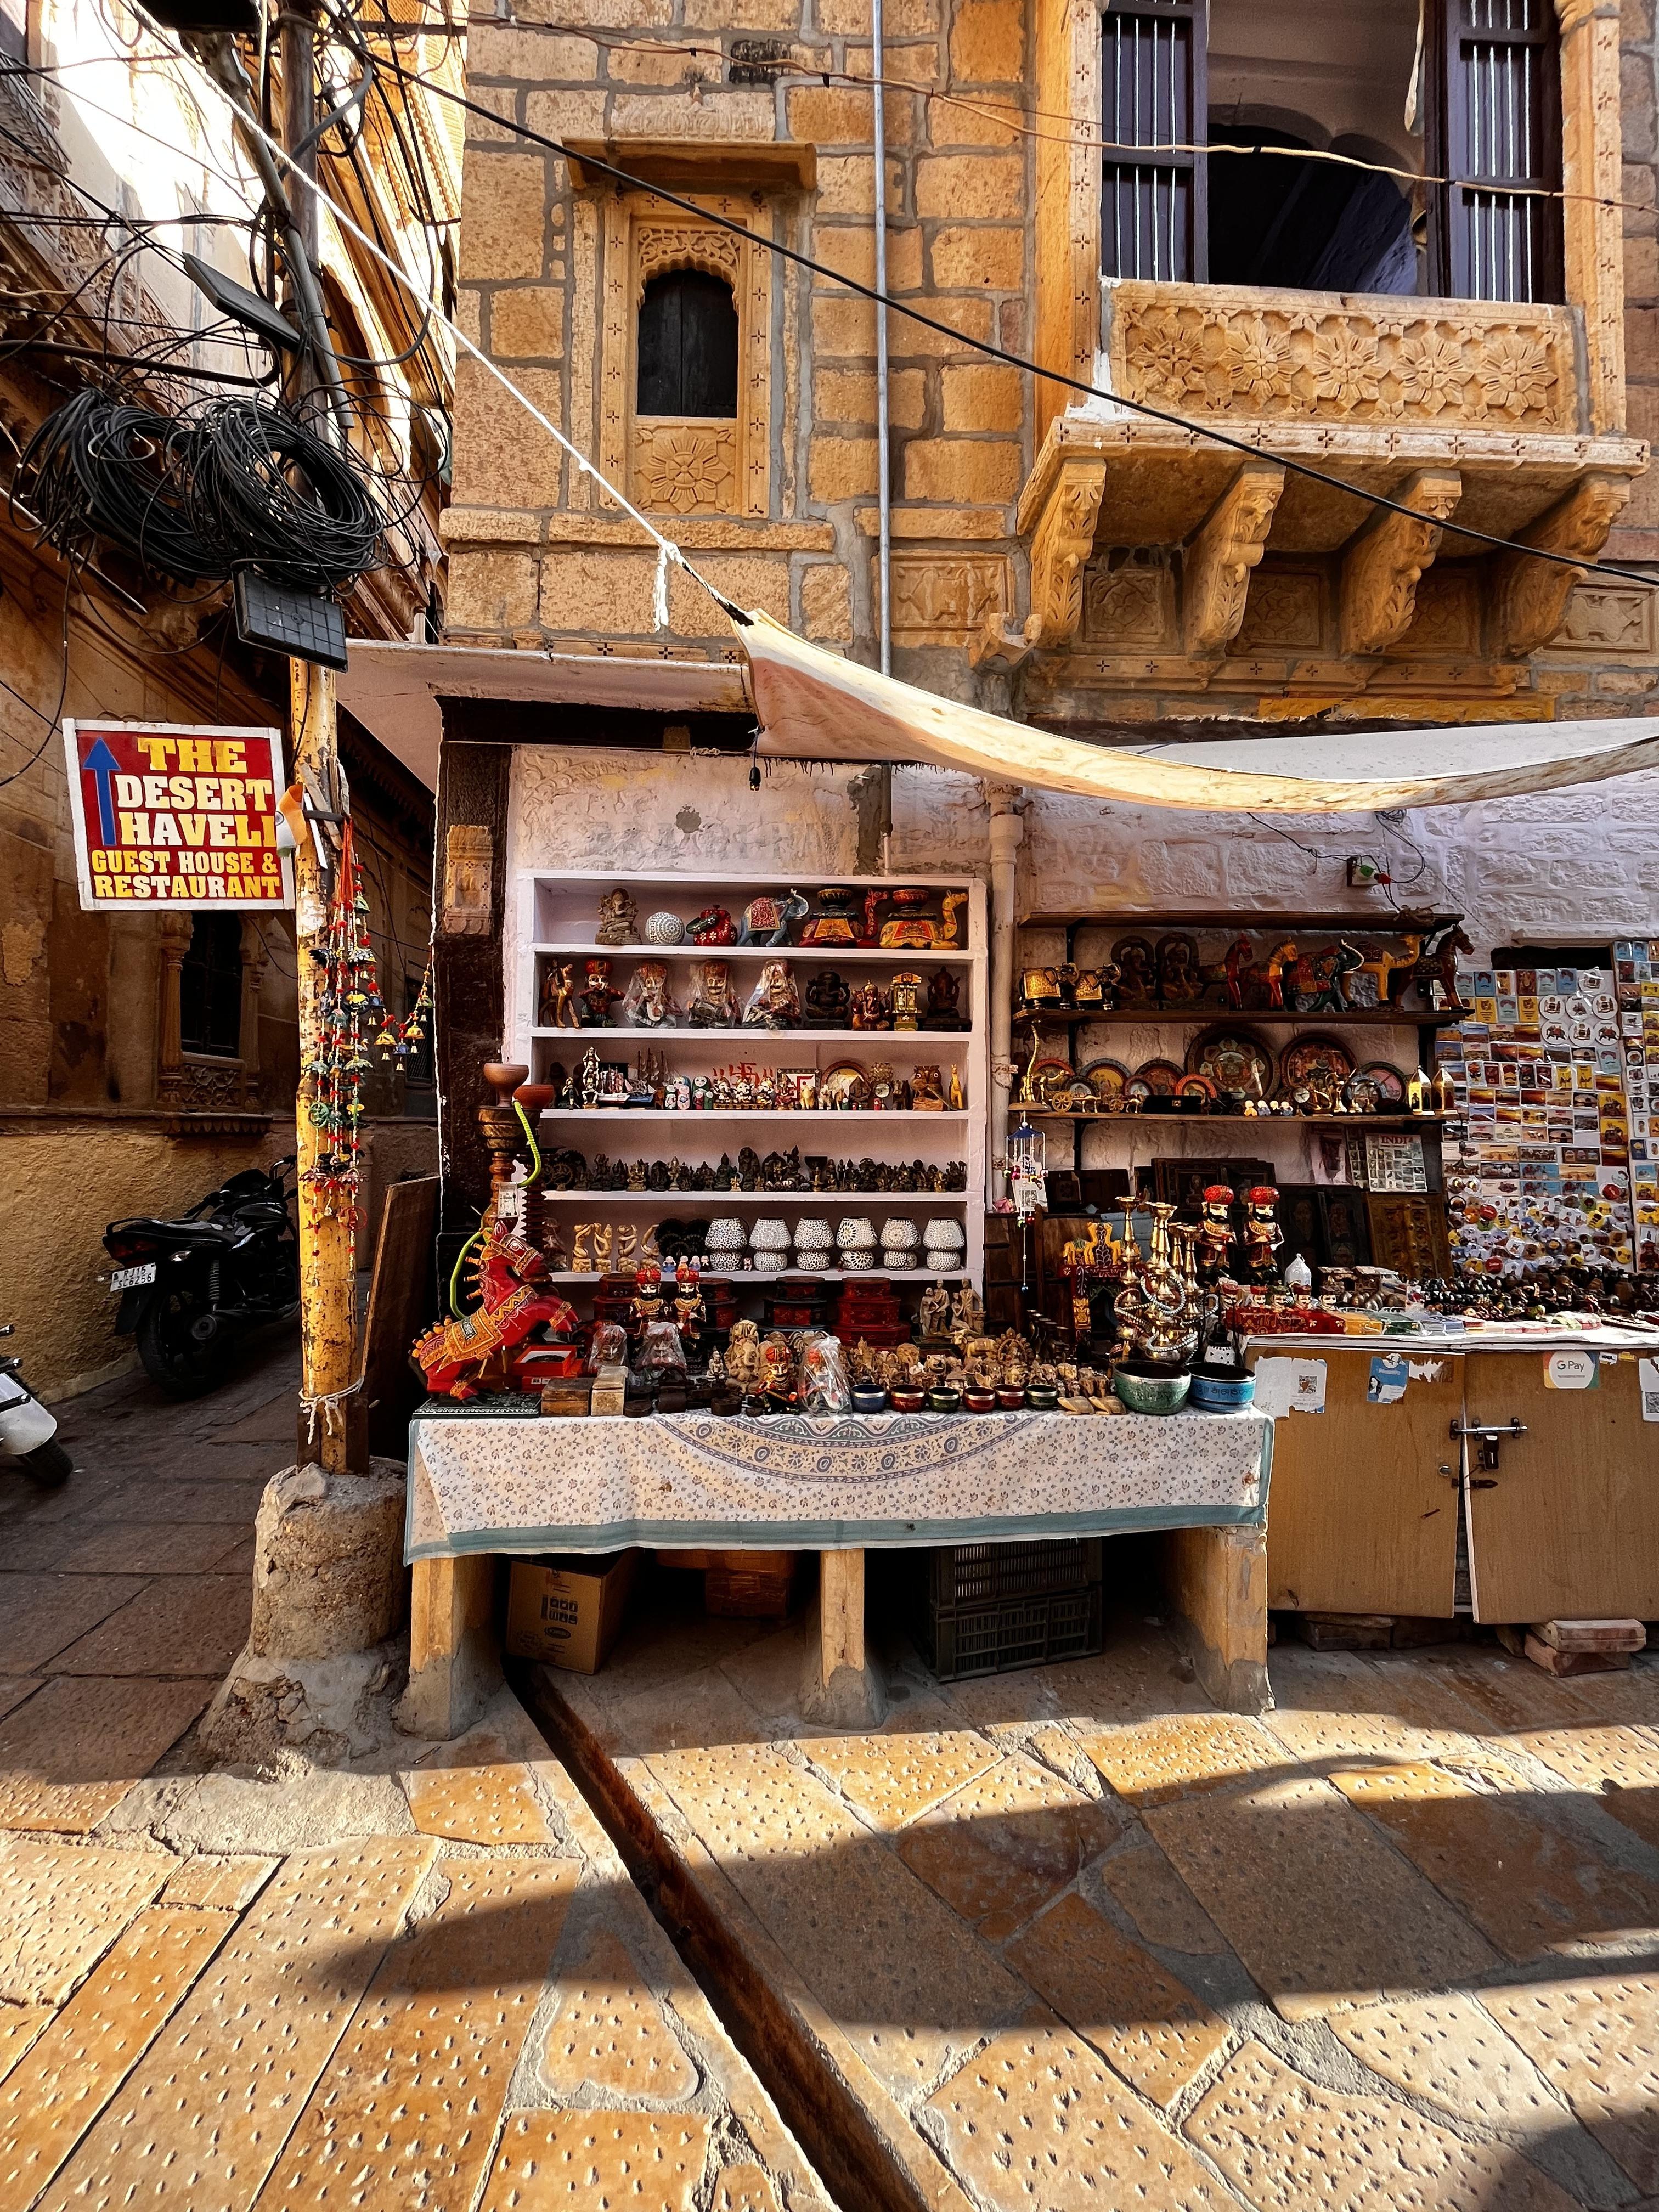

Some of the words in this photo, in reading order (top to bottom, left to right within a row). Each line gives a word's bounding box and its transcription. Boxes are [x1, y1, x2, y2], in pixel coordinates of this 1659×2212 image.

[137, 737, 247, 773] THE
[115, 774, 272, 811] DESERT
[119, 812, 277, 847] HAVELI
[91, 850, 171, 873] GUEST
[178, 851, 255, 874] HOUSE
[262, 854, 279, 873] &
[93, 874, 280, 898] RESTAURANT
[123, 1266, 146, 1278] RJ15
[1568, 1360, 1584, 1372] Pay
